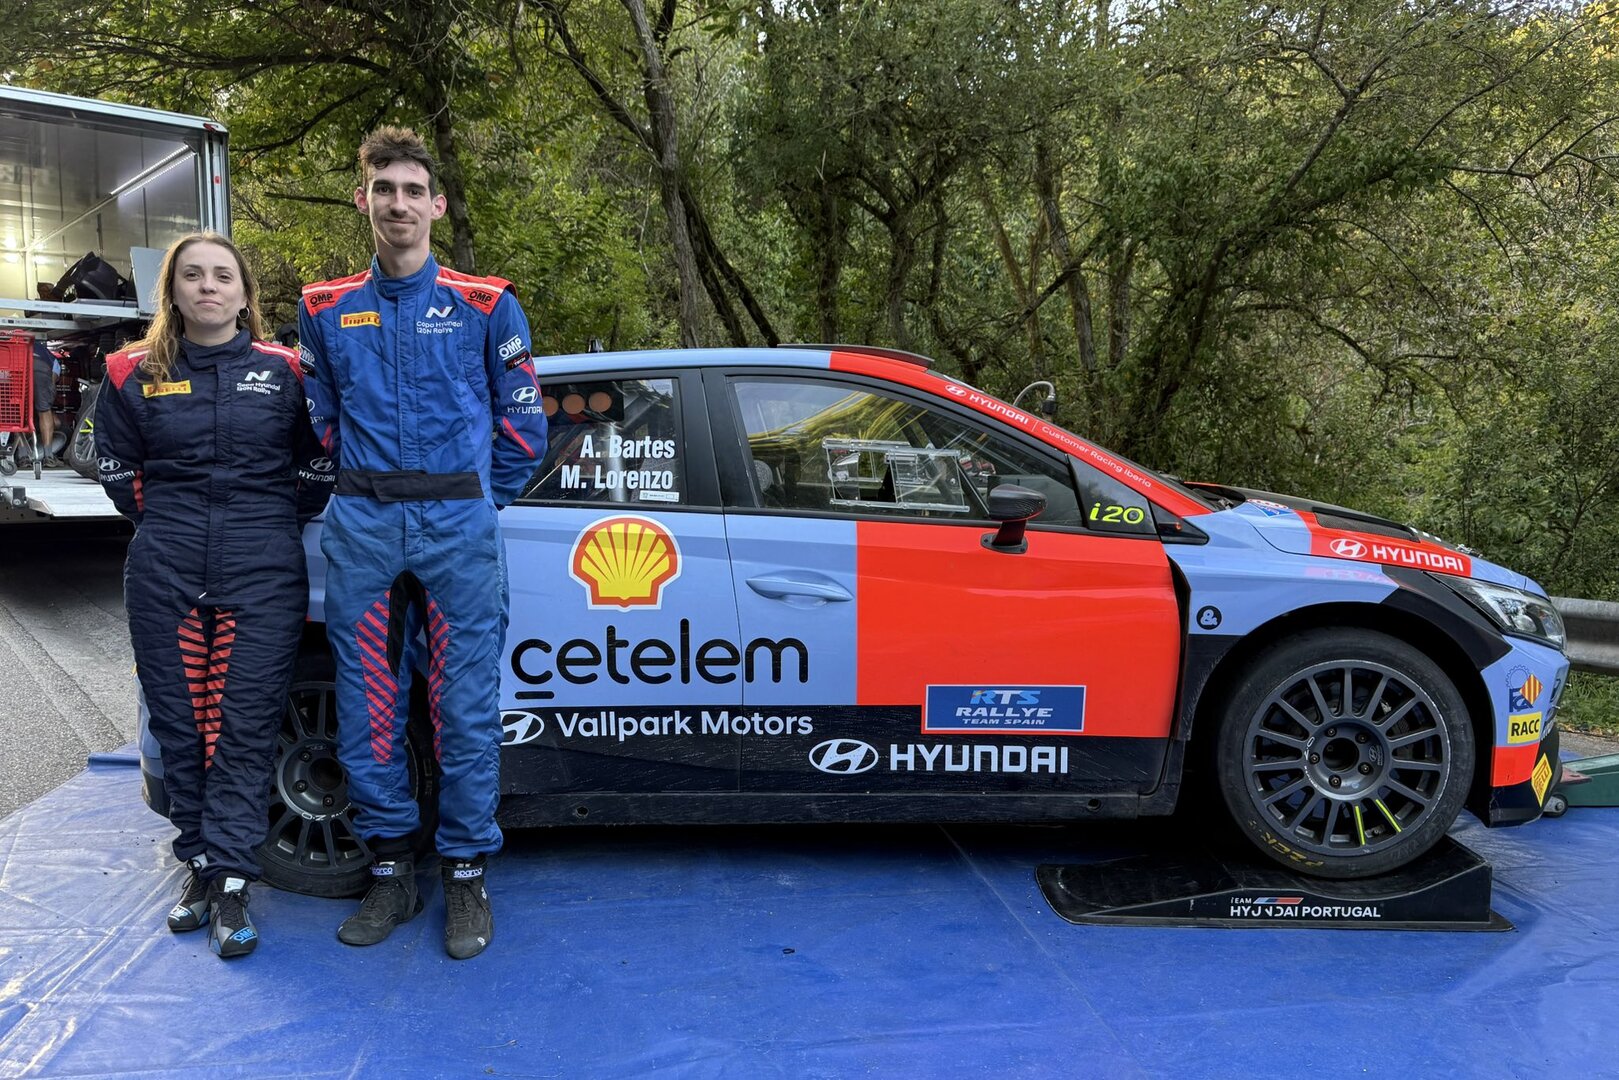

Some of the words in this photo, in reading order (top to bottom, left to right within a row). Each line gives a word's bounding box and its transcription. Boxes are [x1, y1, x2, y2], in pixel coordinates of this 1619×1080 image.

[310, 293, 333, 305] OMP
[469, 290, 492, 302] OMP
[498, 337, 522, 358] OMP
[580, 434, 601, 459] A.
[609, 434, 675, 459] Bartes
[969, 393, 1029, 425] HYUNDAI
[1041, 426, 1089, 454] Customer
[1090, 449, 1122, 474] Racing
[1123, 469, 1152, 488] Iberia
[560, 464, 587, 489] M.
[594, 464, 674, 490] Lorenzo
[1089, 502, 1145, 525] i20
[1372, 544, 1464, 572] HYUNDAI
[511, 618, 808, 688] cetelem
[970, 689, 1042, 705] RTS
[955, 707, 1054, 718] RALLYE
[1003, 718, 1045, 726] SPAIN
[555, 710, 693, 742] Vallpark
[701, 711, 814, 735] Motors
[1511, 718, 1540, 737] RACC
[889, 743, 1069, 774] HYUNDAI
[453, 867, 483, 878] sparco
[1302, 906, 1382, 918] PORTUGAL
